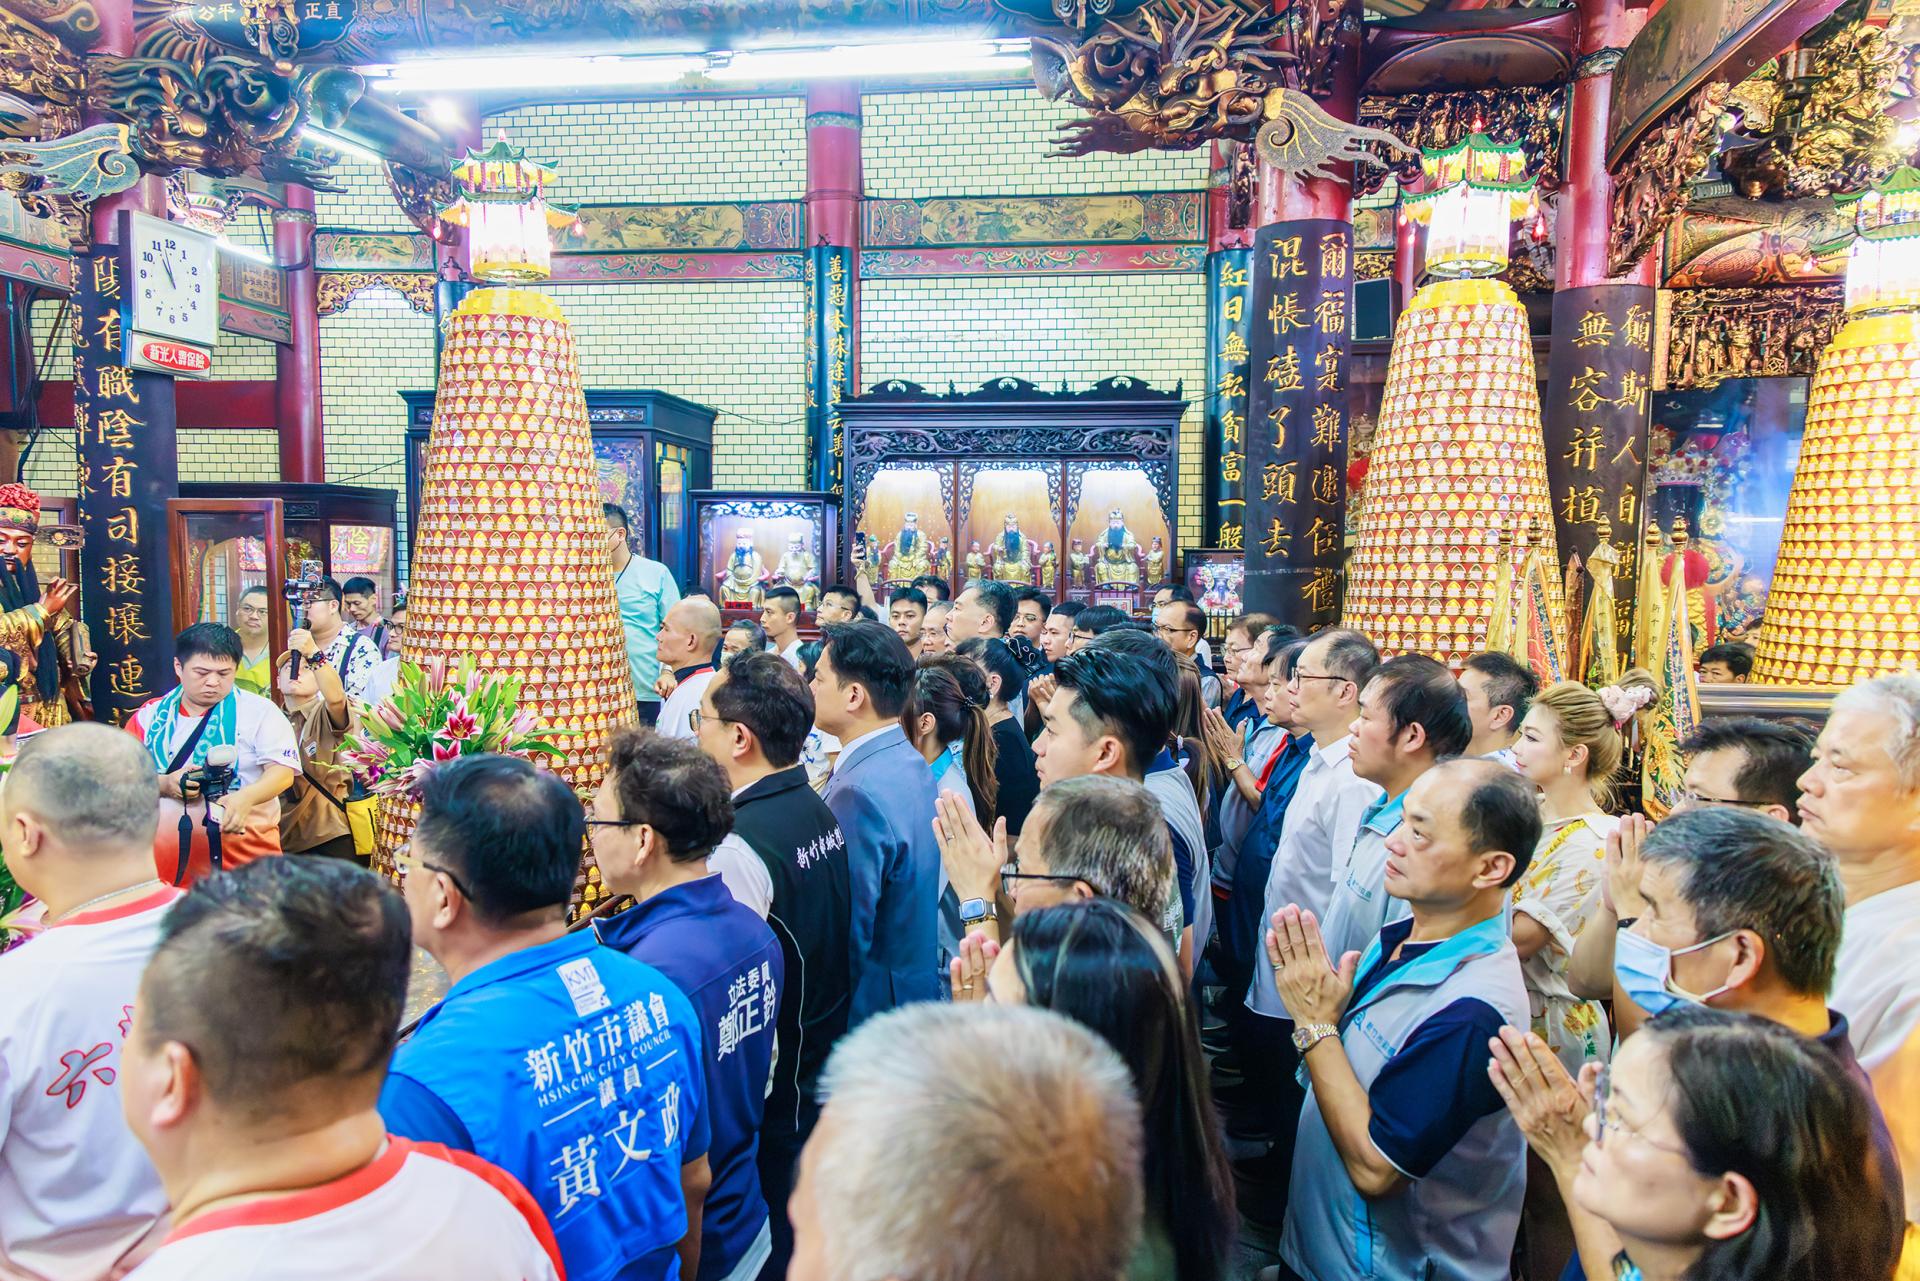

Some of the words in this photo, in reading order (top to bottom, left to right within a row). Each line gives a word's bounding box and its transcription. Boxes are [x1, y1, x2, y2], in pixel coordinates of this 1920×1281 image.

[304, 1, 344, 21] 正直
[152, 240, 161, 251] 11
[165, 239, 176, 250] 12
[143, 251, 153, 262] 10
[182, 250, 187, 260] 1
[140, 269, 147, 279] 9
[191, 267, 197, 276] 2
[194, 283, 201, 293] 3
[145, 289, 152, 299] 8
[155, 306, 163, 316] 7
[190, 301, 197, 310] 4
[169, 314, 175, 324] 6
[182, 312, 188, 322] 5
[1257, 234, 1312, 558] 混帳磕了頭去
[1215, 261, 1250, 549] 紅日無私貧富一般
[728, 960, 771, 1009] 立法委員
[524, 991, 671, 1093] 新竹市議會
[537, 1072, 596, 1108] HSINCHU
[598, 1051, 628, 1077] CITY
[630, 1033, 672, 1060] COUNCIL
[597, 1062, 644, 1110] 議員
